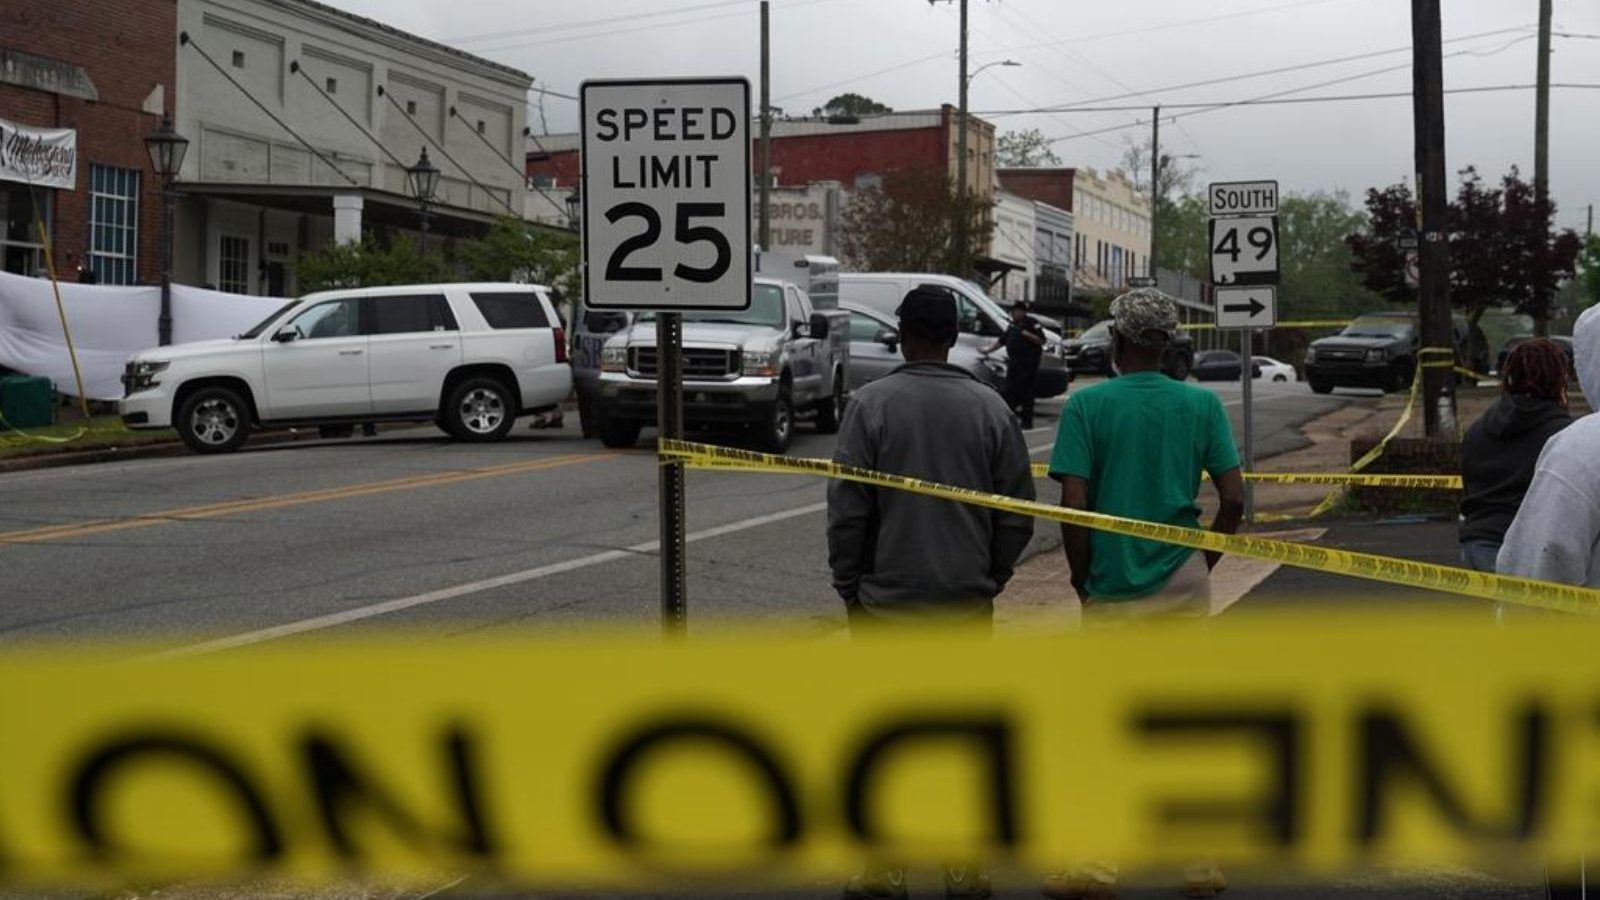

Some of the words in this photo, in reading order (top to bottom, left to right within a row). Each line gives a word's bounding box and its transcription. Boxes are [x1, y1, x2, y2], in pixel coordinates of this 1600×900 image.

[596, 107, 736, 141] SPEED
[613, 155, 718, 188] LIMIT
[768, 202, 824, 220] BROS.
[1214, 188, 1274, 209] SOUTH
[604, 202, 732, 283] 25
[754, 228, 814, 246] TURE
[1214, 226, 1274, 262] 49
[54, 720, 495, 859] NO
[1126, 702, 1550, 846] NE
